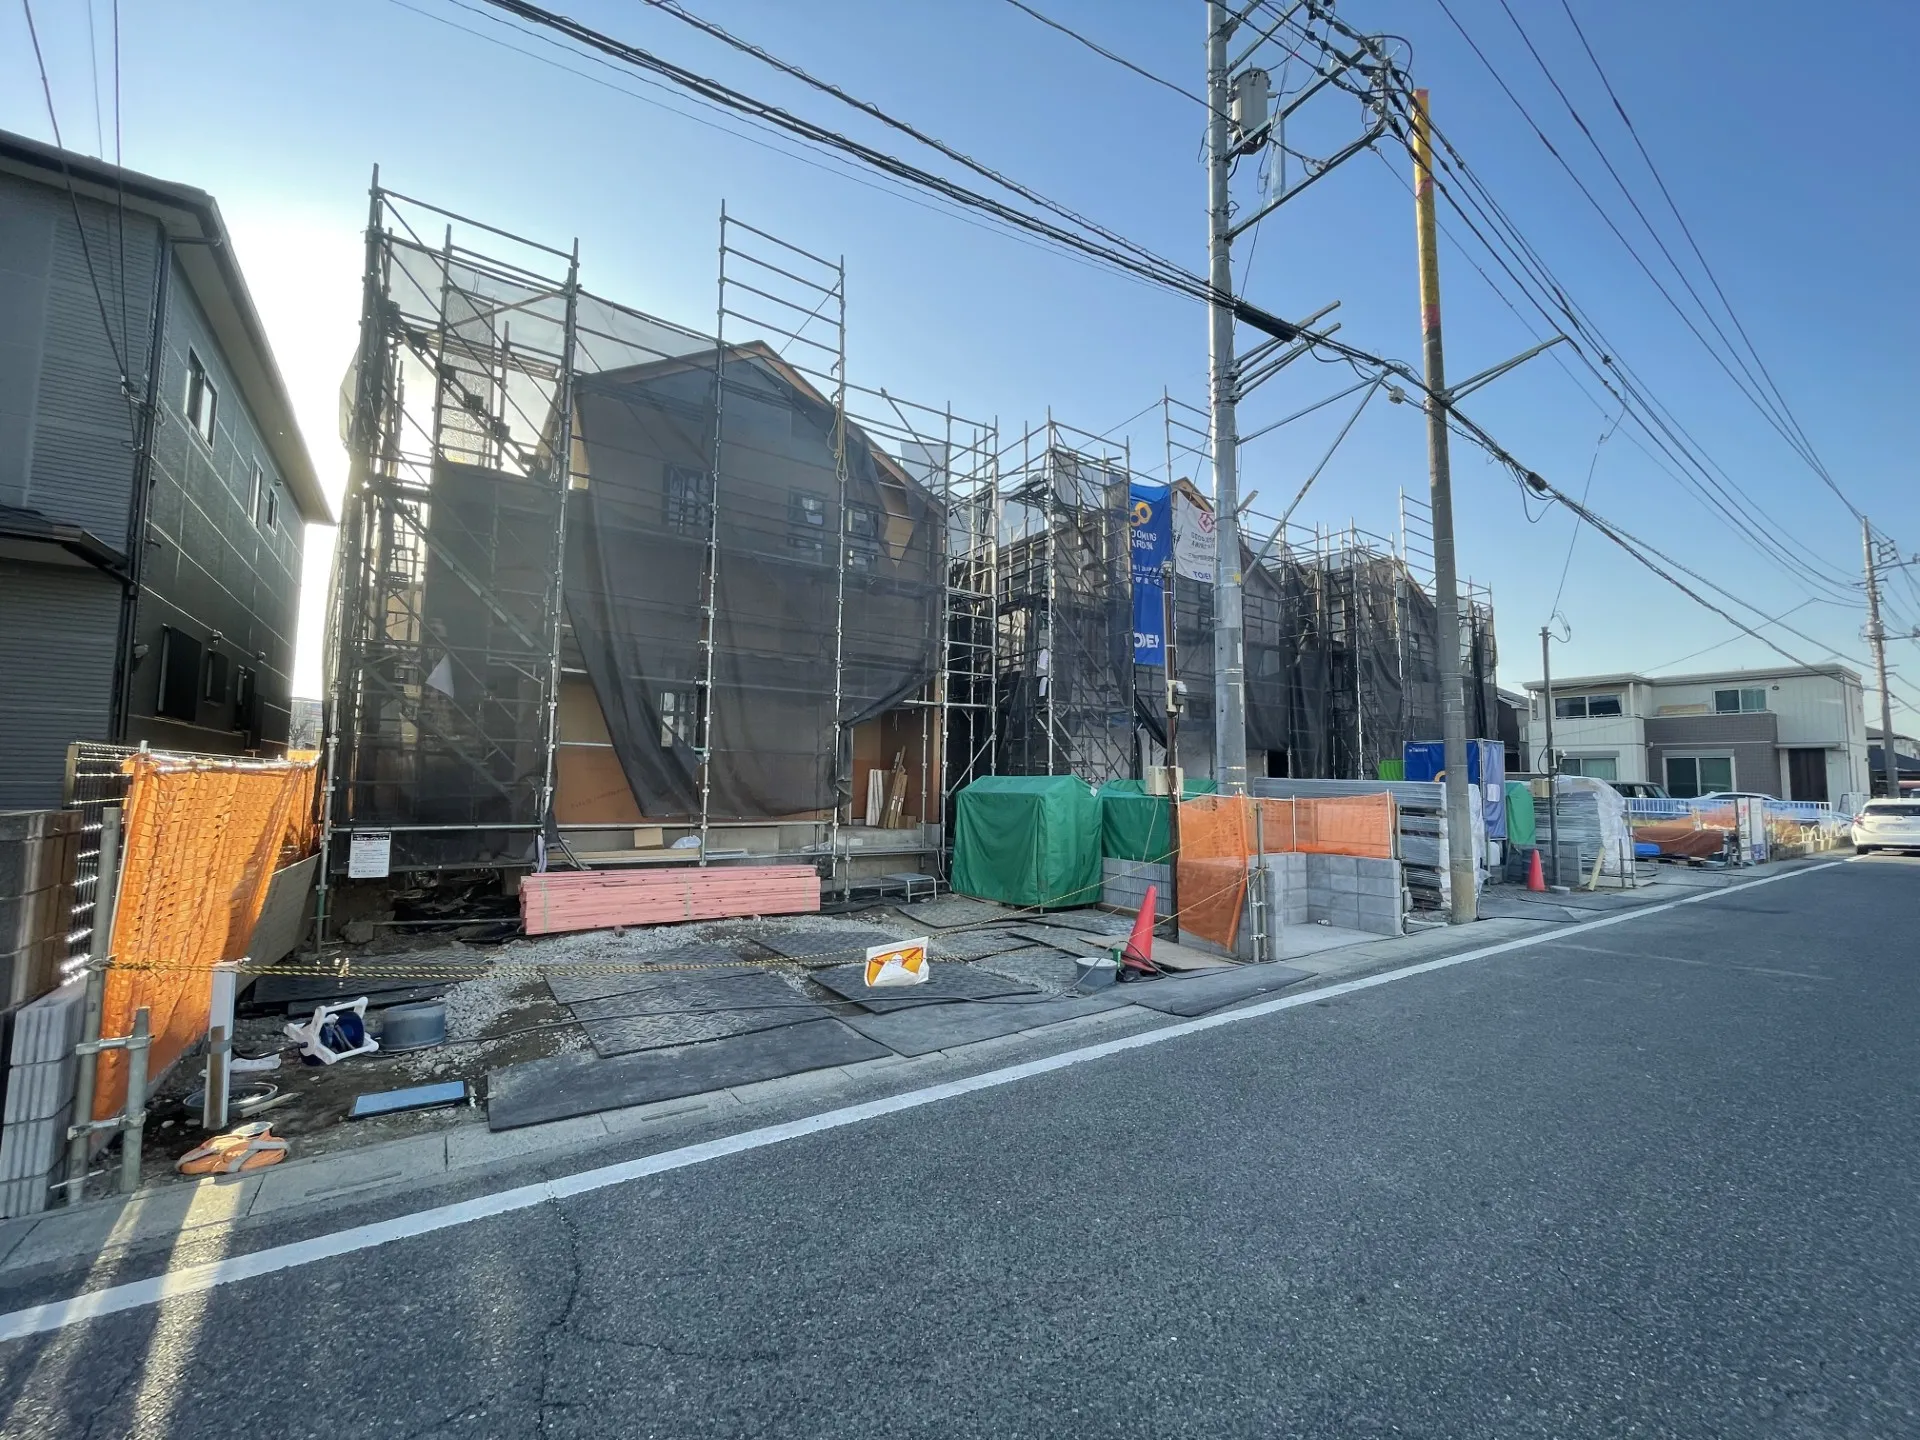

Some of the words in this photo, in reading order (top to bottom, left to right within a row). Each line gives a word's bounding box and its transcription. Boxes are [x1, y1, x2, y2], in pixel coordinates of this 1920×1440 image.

[1131, 528, 1157, 542] OOMING
[1131, 539, 1154, 550] ARDEN
[1133, 632, 1160, 649] OEI
